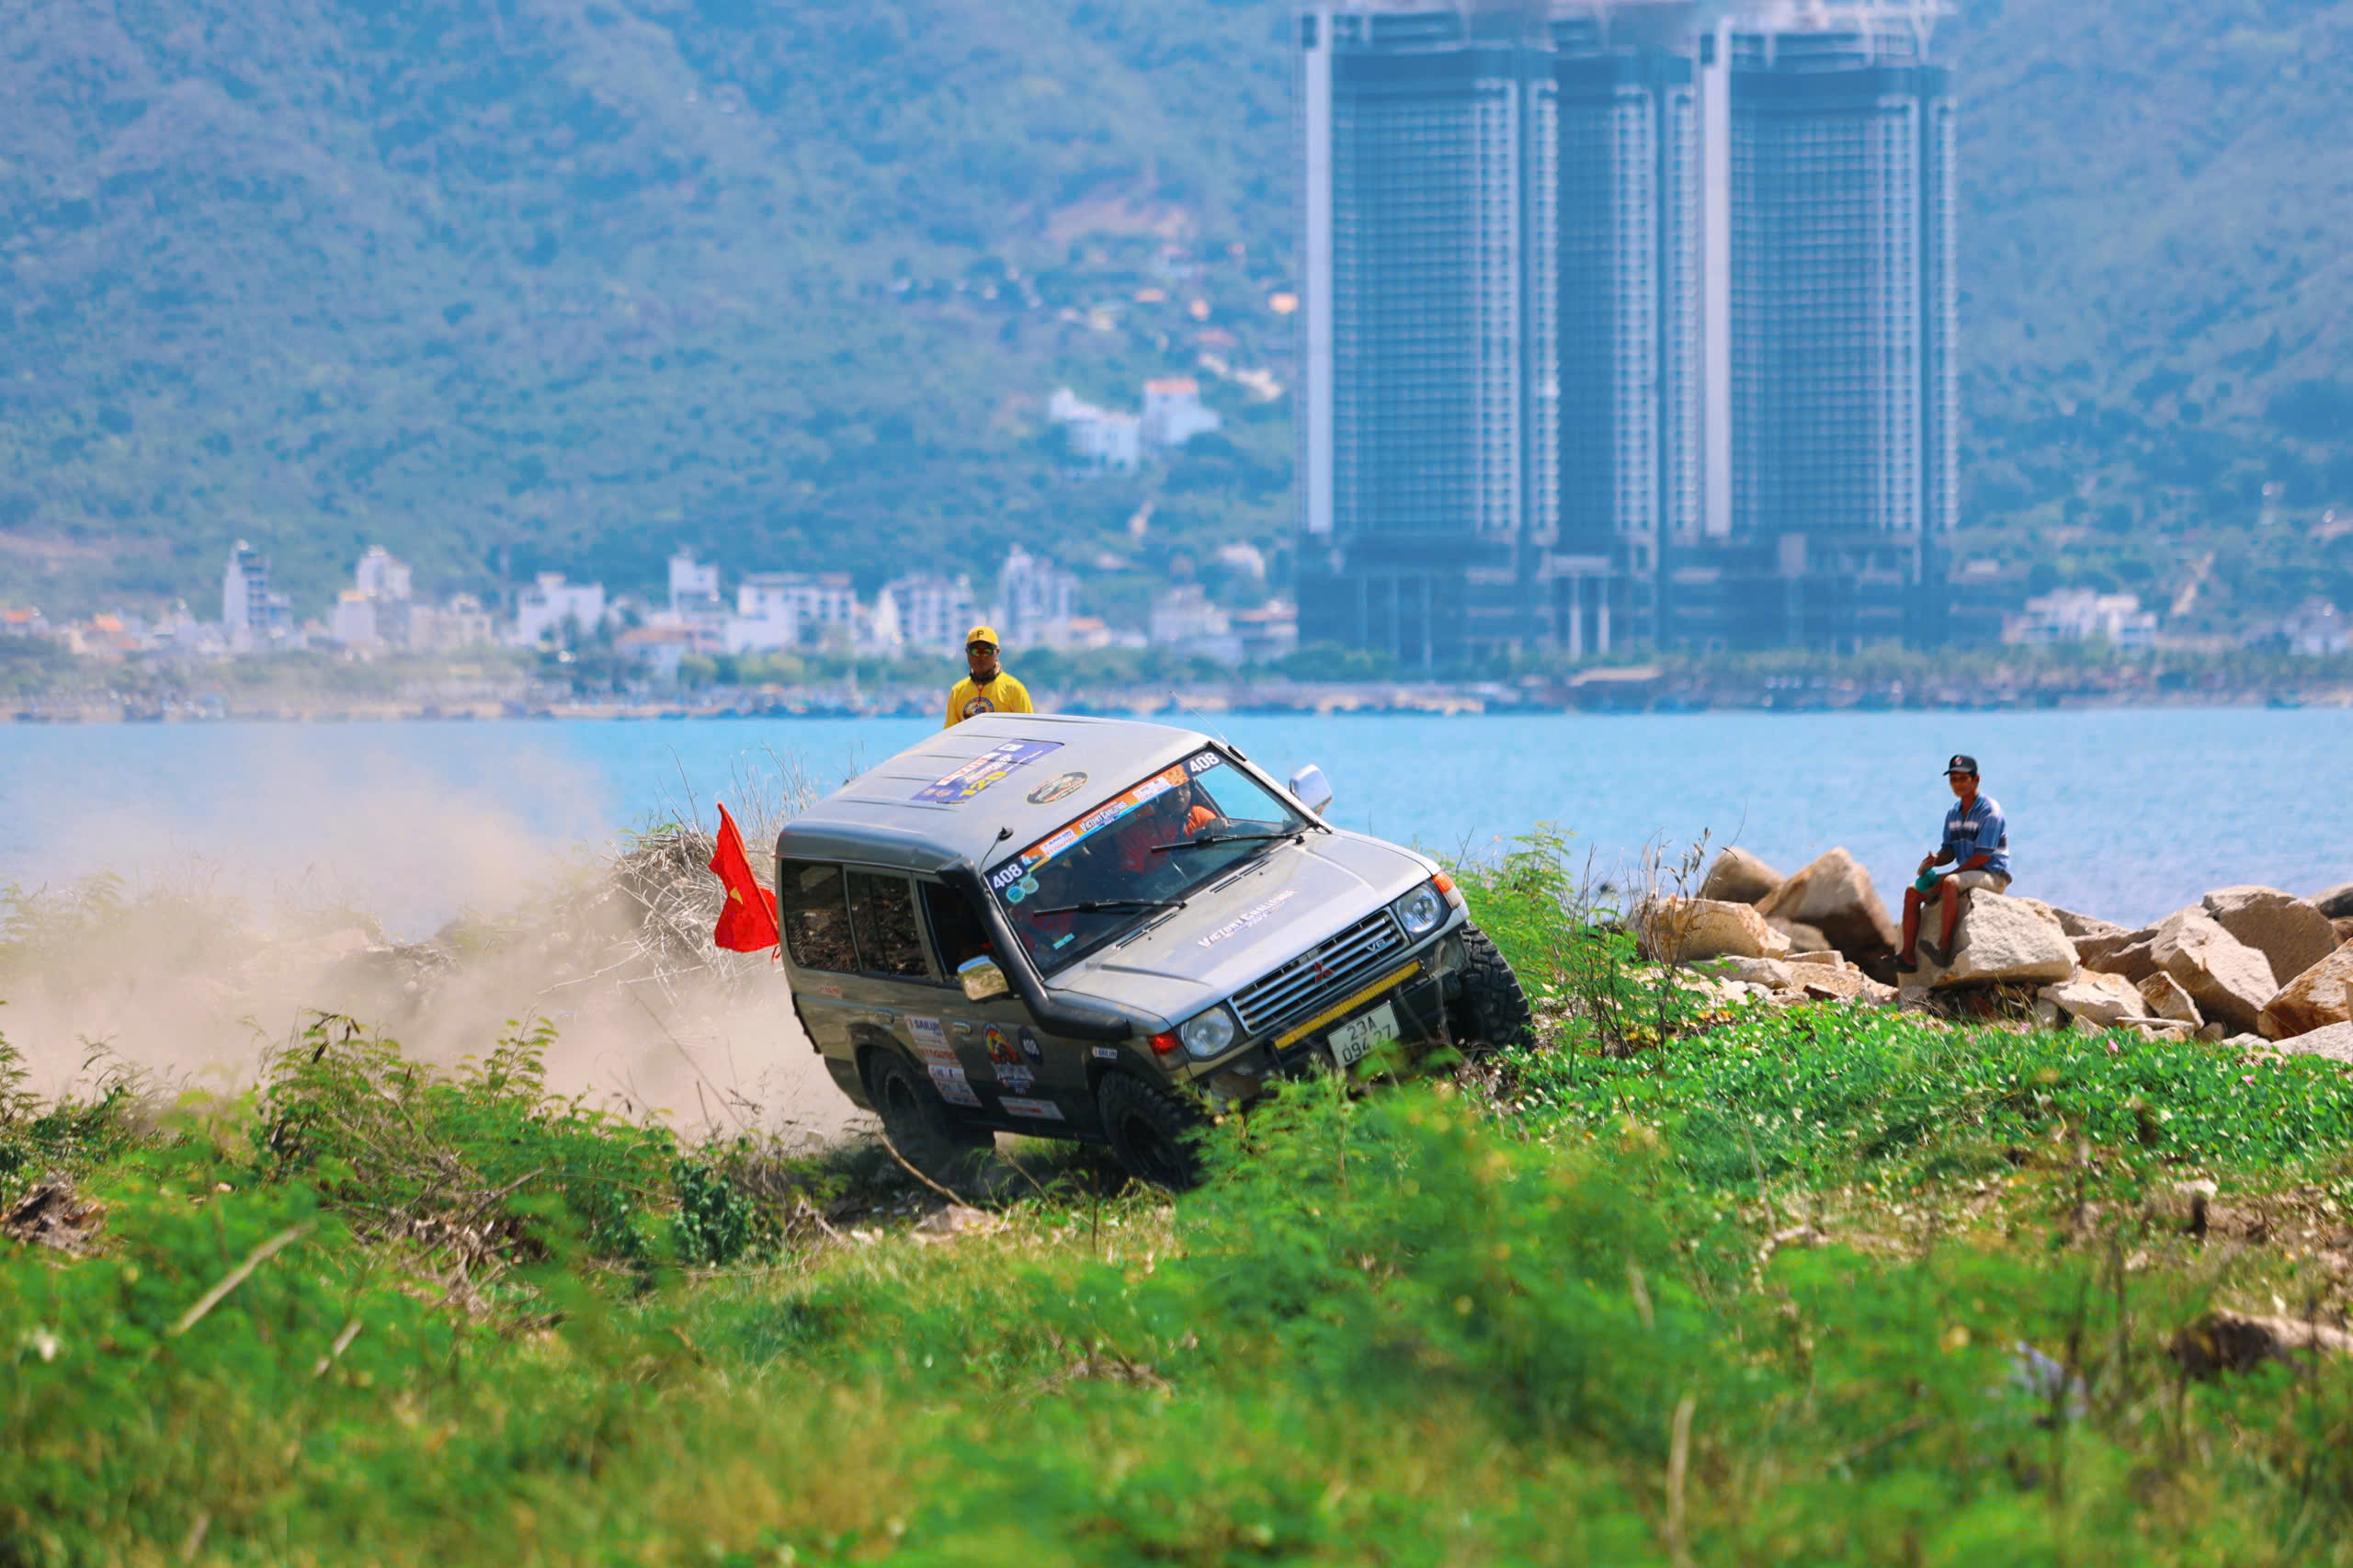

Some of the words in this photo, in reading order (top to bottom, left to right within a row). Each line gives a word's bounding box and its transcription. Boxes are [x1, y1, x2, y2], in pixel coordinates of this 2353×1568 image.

[975, 630, 985, 639] P
[1188, 751, 1220, 773] 408
[959, 771, 1008, 797] 120
[993, 863, 1023, 890] 408
[1198, 918, 1244, 949] VICTORY
[1366, 938, 1386, 953] V6
[914, 1018, 942, 1031] SAILUN
[1347, 1016, 1377, 1041] 23A
